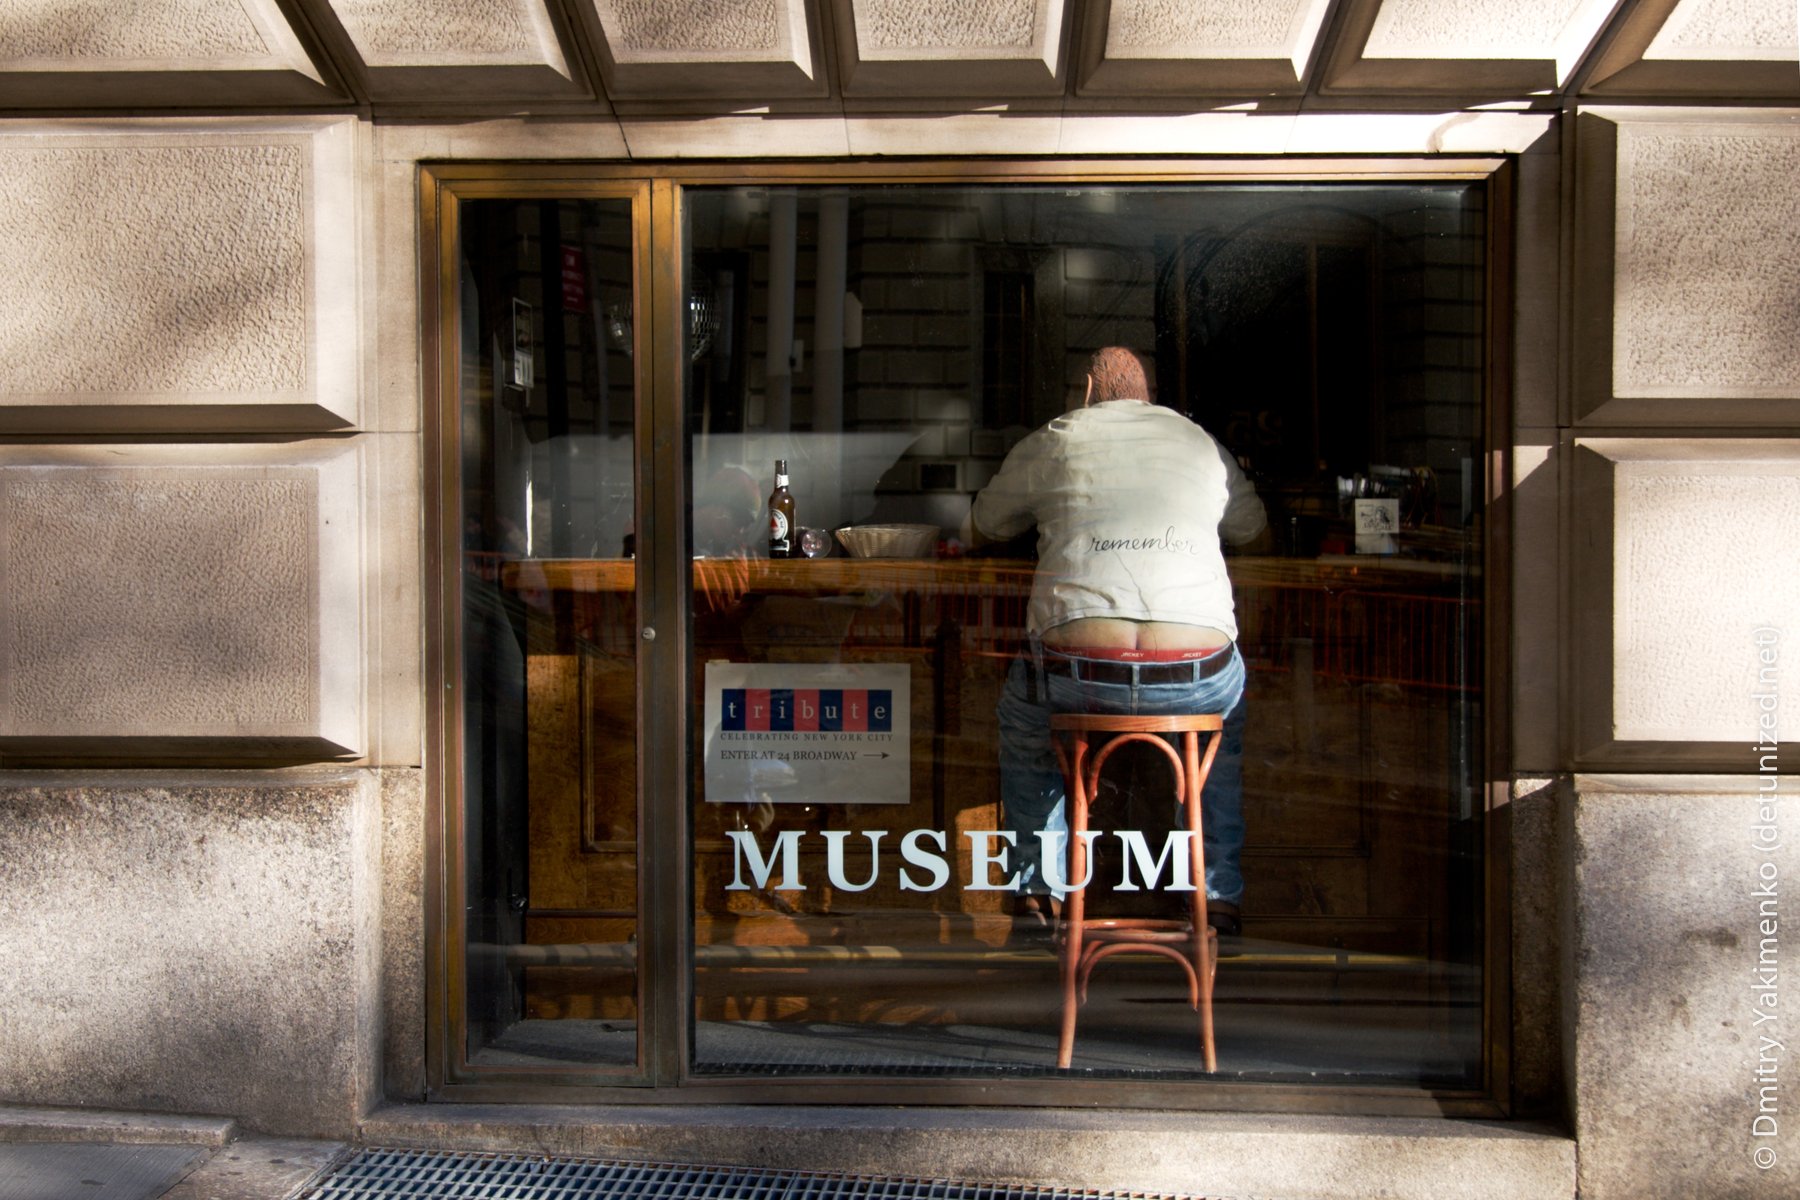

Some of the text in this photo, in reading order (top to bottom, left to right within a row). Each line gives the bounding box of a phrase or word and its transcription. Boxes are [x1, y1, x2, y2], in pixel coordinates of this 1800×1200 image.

[1085, 525, 1200, 555] remember
[728, 700, 886, 719] tribute
[720, 733, 893, 742] CELEBRATING NEW YORK CITY
[721, 750, 857, 761] ENTER AT 24 BROADWAY
[724, 829, 1198, 892] MUSEUM
